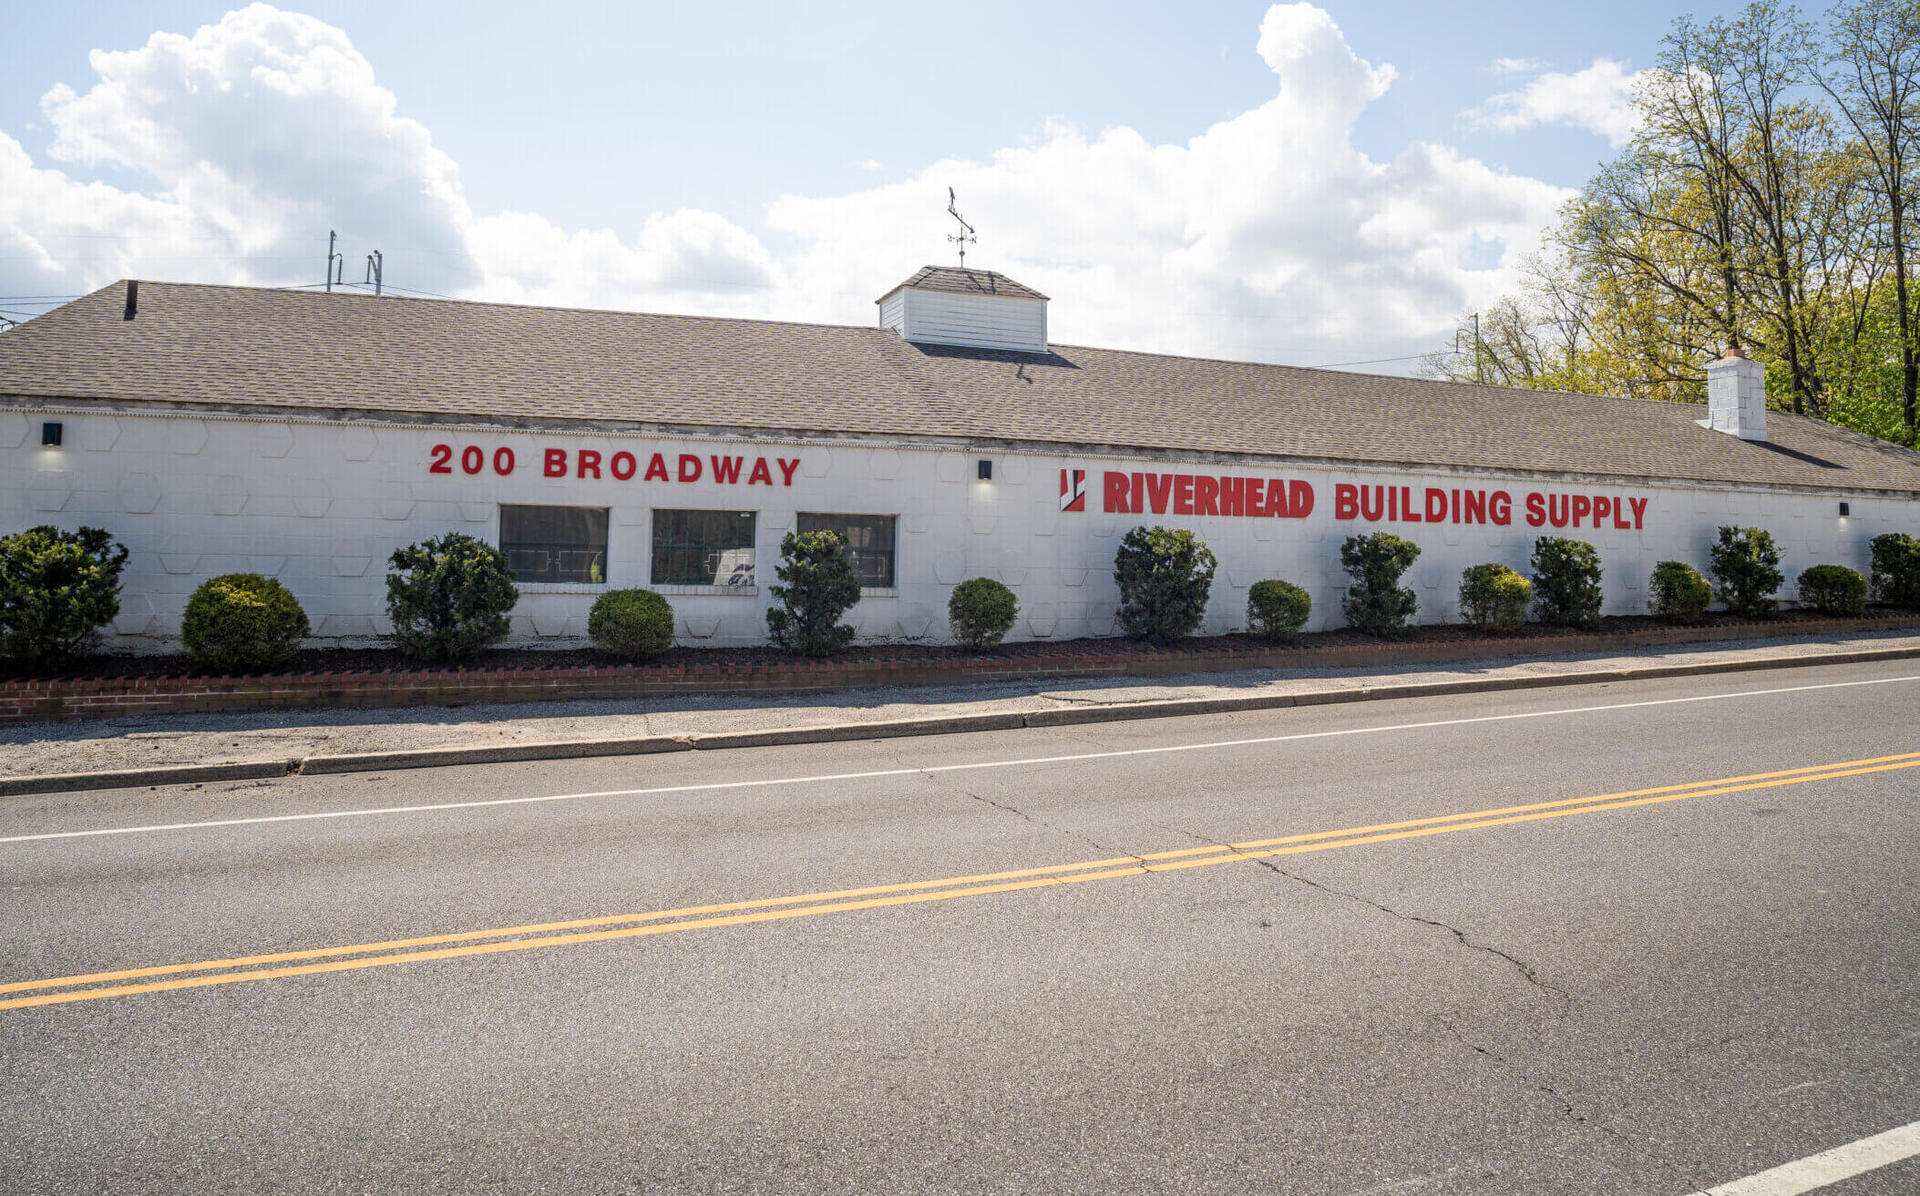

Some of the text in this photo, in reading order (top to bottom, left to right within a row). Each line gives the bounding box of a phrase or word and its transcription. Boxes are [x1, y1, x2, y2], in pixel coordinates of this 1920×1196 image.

[429, 444, 801, 487] 200 BROADWAY
[1103, 471, 1649, 530] RIVERHEAD BUILDING SUPPLY
